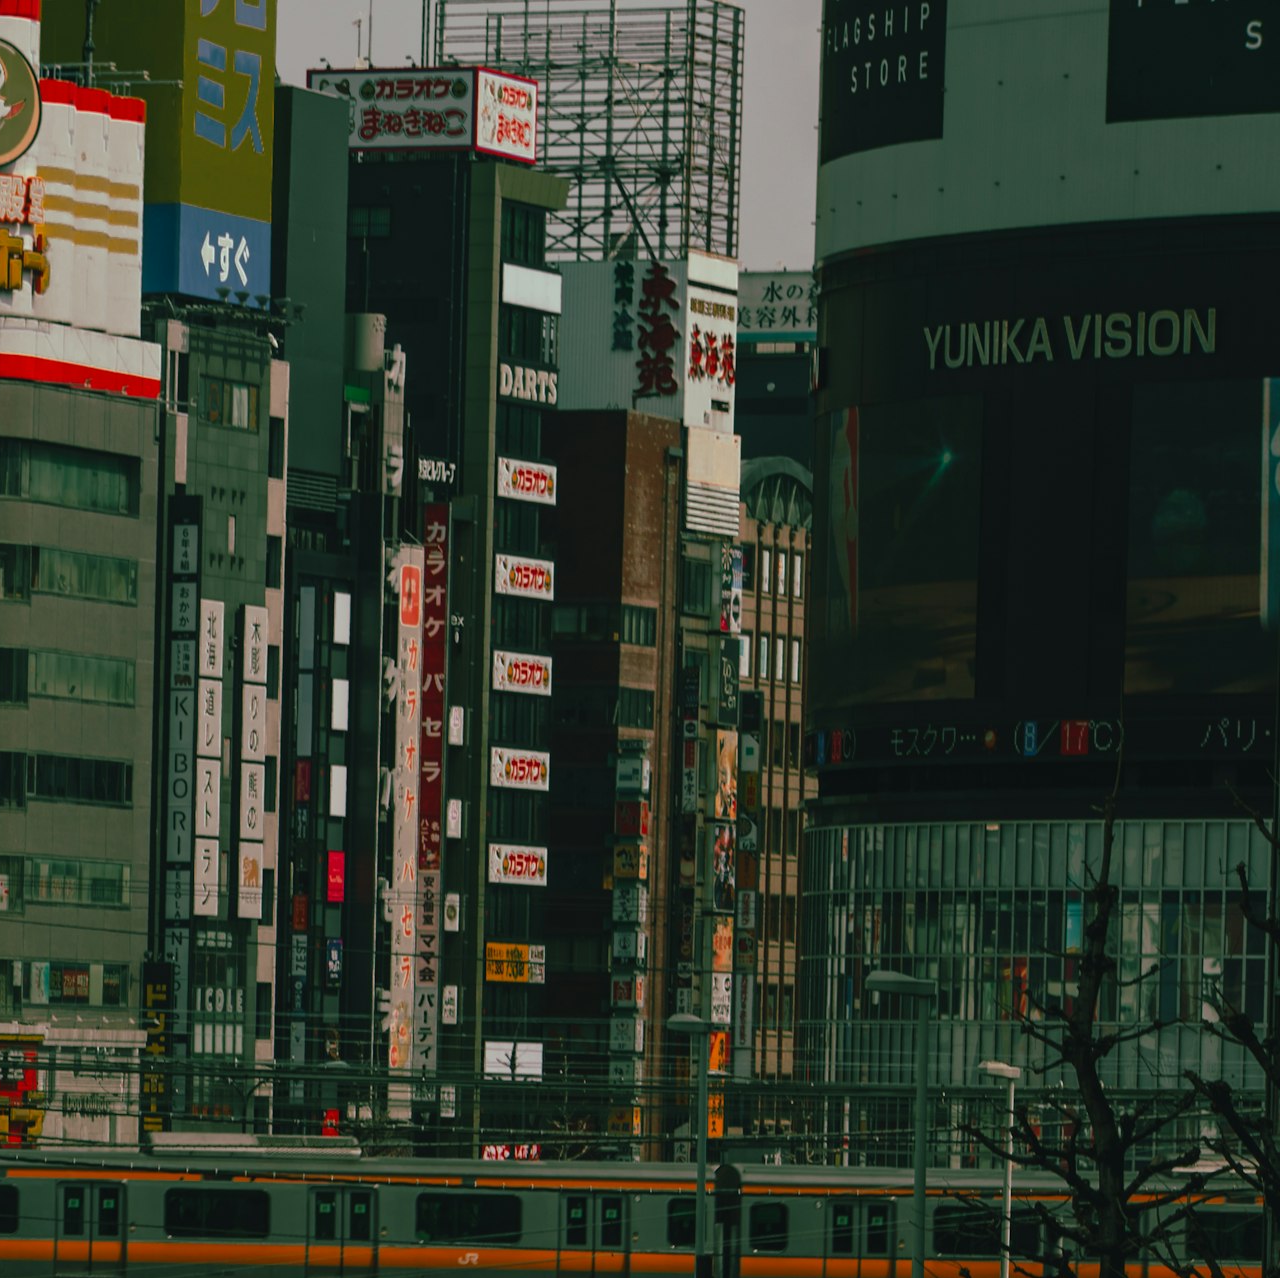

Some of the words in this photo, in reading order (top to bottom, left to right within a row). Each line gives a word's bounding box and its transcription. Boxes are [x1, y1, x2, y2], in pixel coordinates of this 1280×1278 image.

[826, 2, 931, 55] FLAGSHIP
[374, 78, 452, 99] カラオケ
[850, 51, 929, 94] STORE
[501, 85, 529, 109] カラオケ
[361, 108, 467, 140] まねきねこ
[495, 113, 531, 149] まねきねこ
[216, 233, 250, 287] すぐ
[923, 316, 1054, 371] YUNIKA
[1062, 307, 1218, 361] VISION
[498, 363, 558, 405] DARTS
[516, 468, 549, 495] カラオケ
[423, 521, 447, 639] カラオケ
[514, 564, 546, 592] カラオケ
[511, 659, 544, 688] カラオケ
[421, 672, 446, 784] パセラ
[172, 696, 189, 856] KIBORI
[510, 758, 542, 783] カラオケ
[508, 851, 540, 878] カラオケ
[295, 938, 307, 971] ZEST
[419, 933, 436, 983] ママ会
